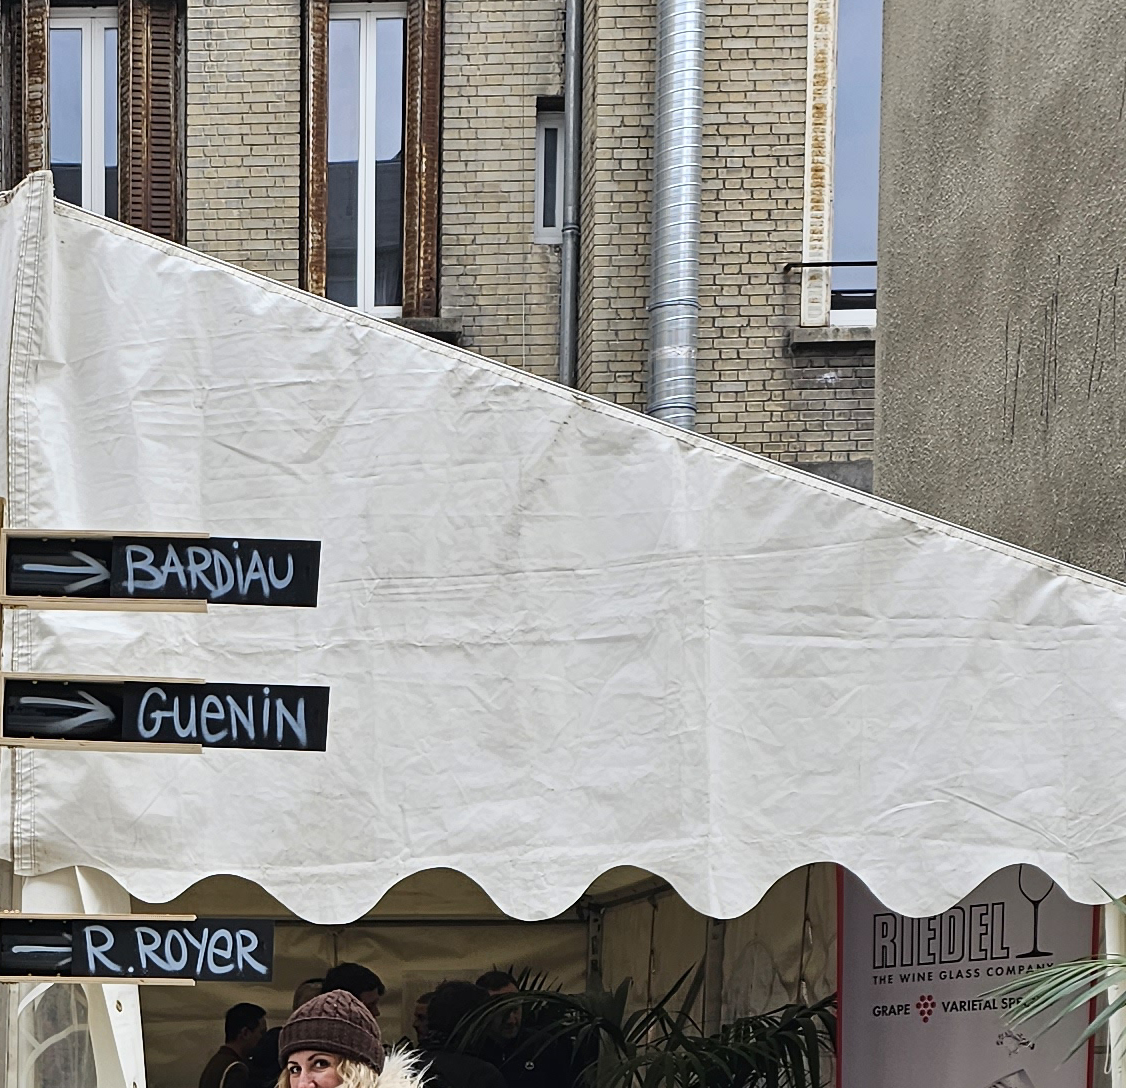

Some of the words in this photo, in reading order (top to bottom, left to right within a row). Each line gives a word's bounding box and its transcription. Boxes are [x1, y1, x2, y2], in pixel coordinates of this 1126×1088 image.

[873, 902, 1010, 969] RIEDEL
[873, 975, 893, 985] THE
[900, 972, 933, 983] WINE
[939, 969, 980, 980] GLASS
[873, 1004, 910, 1017] GRAPE
[942, 998, 998, 1013] VARIETAL
